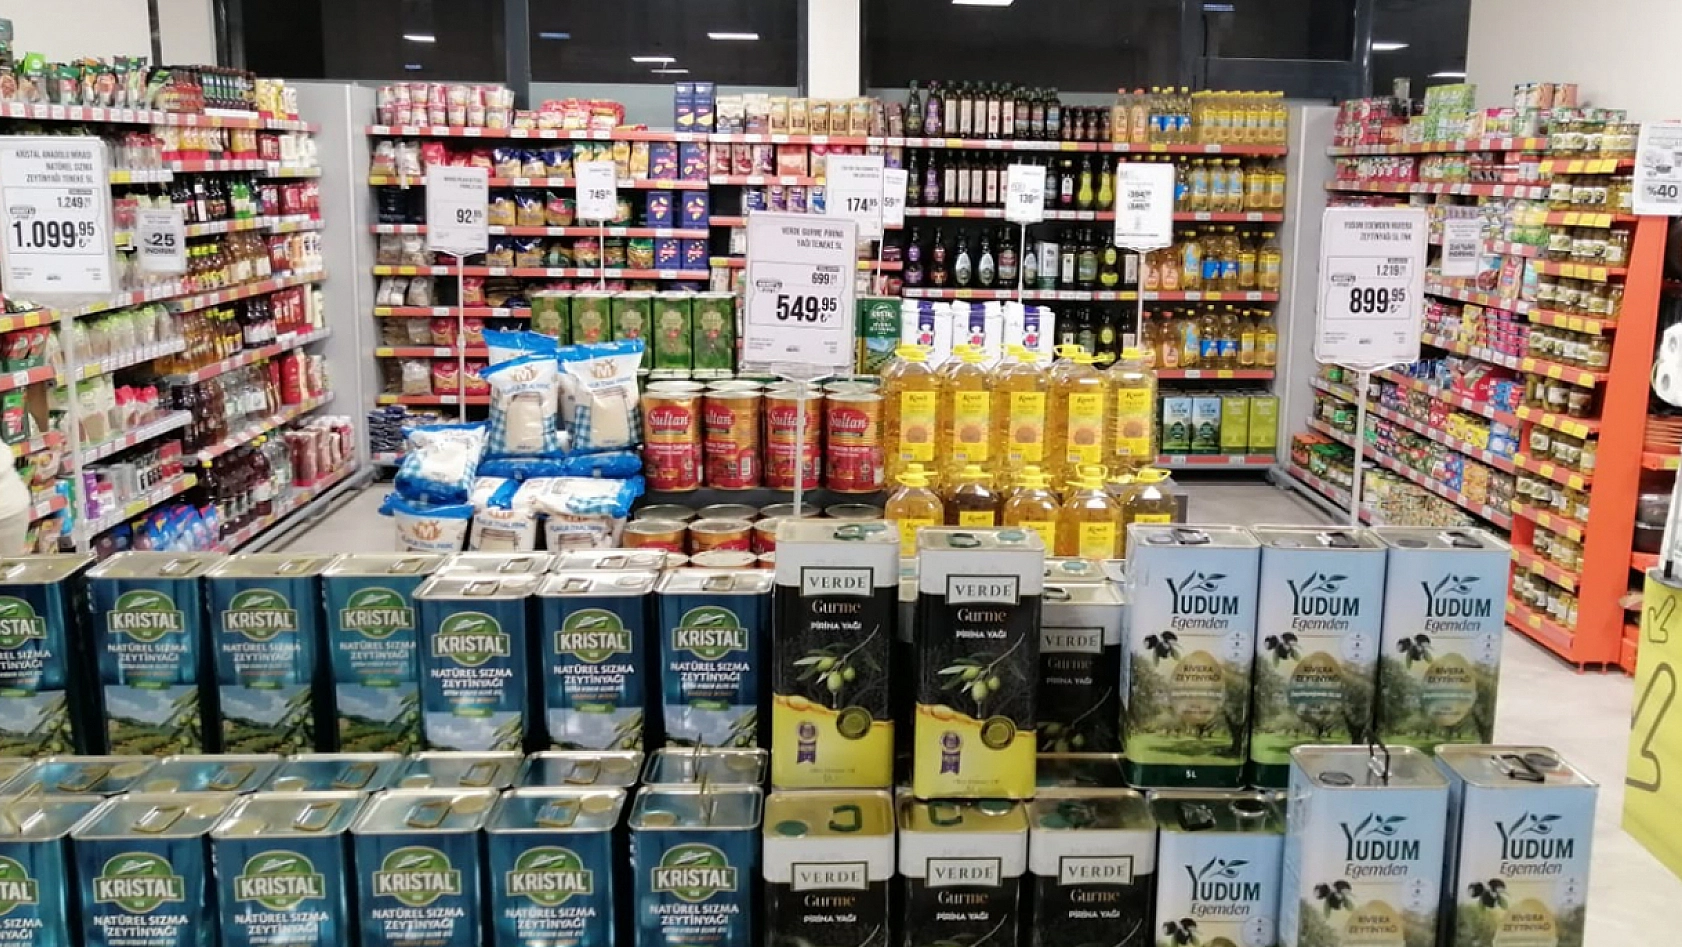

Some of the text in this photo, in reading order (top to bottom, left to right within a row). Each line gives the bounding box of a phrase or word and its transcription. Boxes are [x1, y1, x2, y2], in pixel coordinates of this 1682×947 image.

[650, 410, 688, 426] Sultan
[706, 409, 733, 425] ultan
[830, 412, 866, 429] Sultan
[809, 576, 867, 589] VERDE
[955, 584, 1012, 597] VERDE
[1165, 570, 1239, 615] YUDUM
[1287, 571, 1360, 617] YUDUM
[1421, 572, 1491, 618] YUDUM
[0, 620, 40, 635] STAL
[1171, 616, 1229, 630] Egemden
[1291, 618, 1349, 631] Egemden
[1424, 619, 1481, 632] Egemden
[1045, 635, 1098, 647] VERDE
[0, 659, 43, 669] TİNYAĞI
[1341, 811, 1420, 861] YUDUM
[1495, 811, 1574, 860] YUDUM
[801, 871, 860, 882] VERDE
[935, 866, 994, 879] VERDE
[1068, 865, 1125, 878] VERDE
[1344, 862, 1408, 879] Egemden
[1500, 861, 1562, 878] Egemden
[1185, 856, 1261, 901] YUDUM
[0, 881, 33, 901] TAL
[1190, 902, 1250, 916] Egemden
